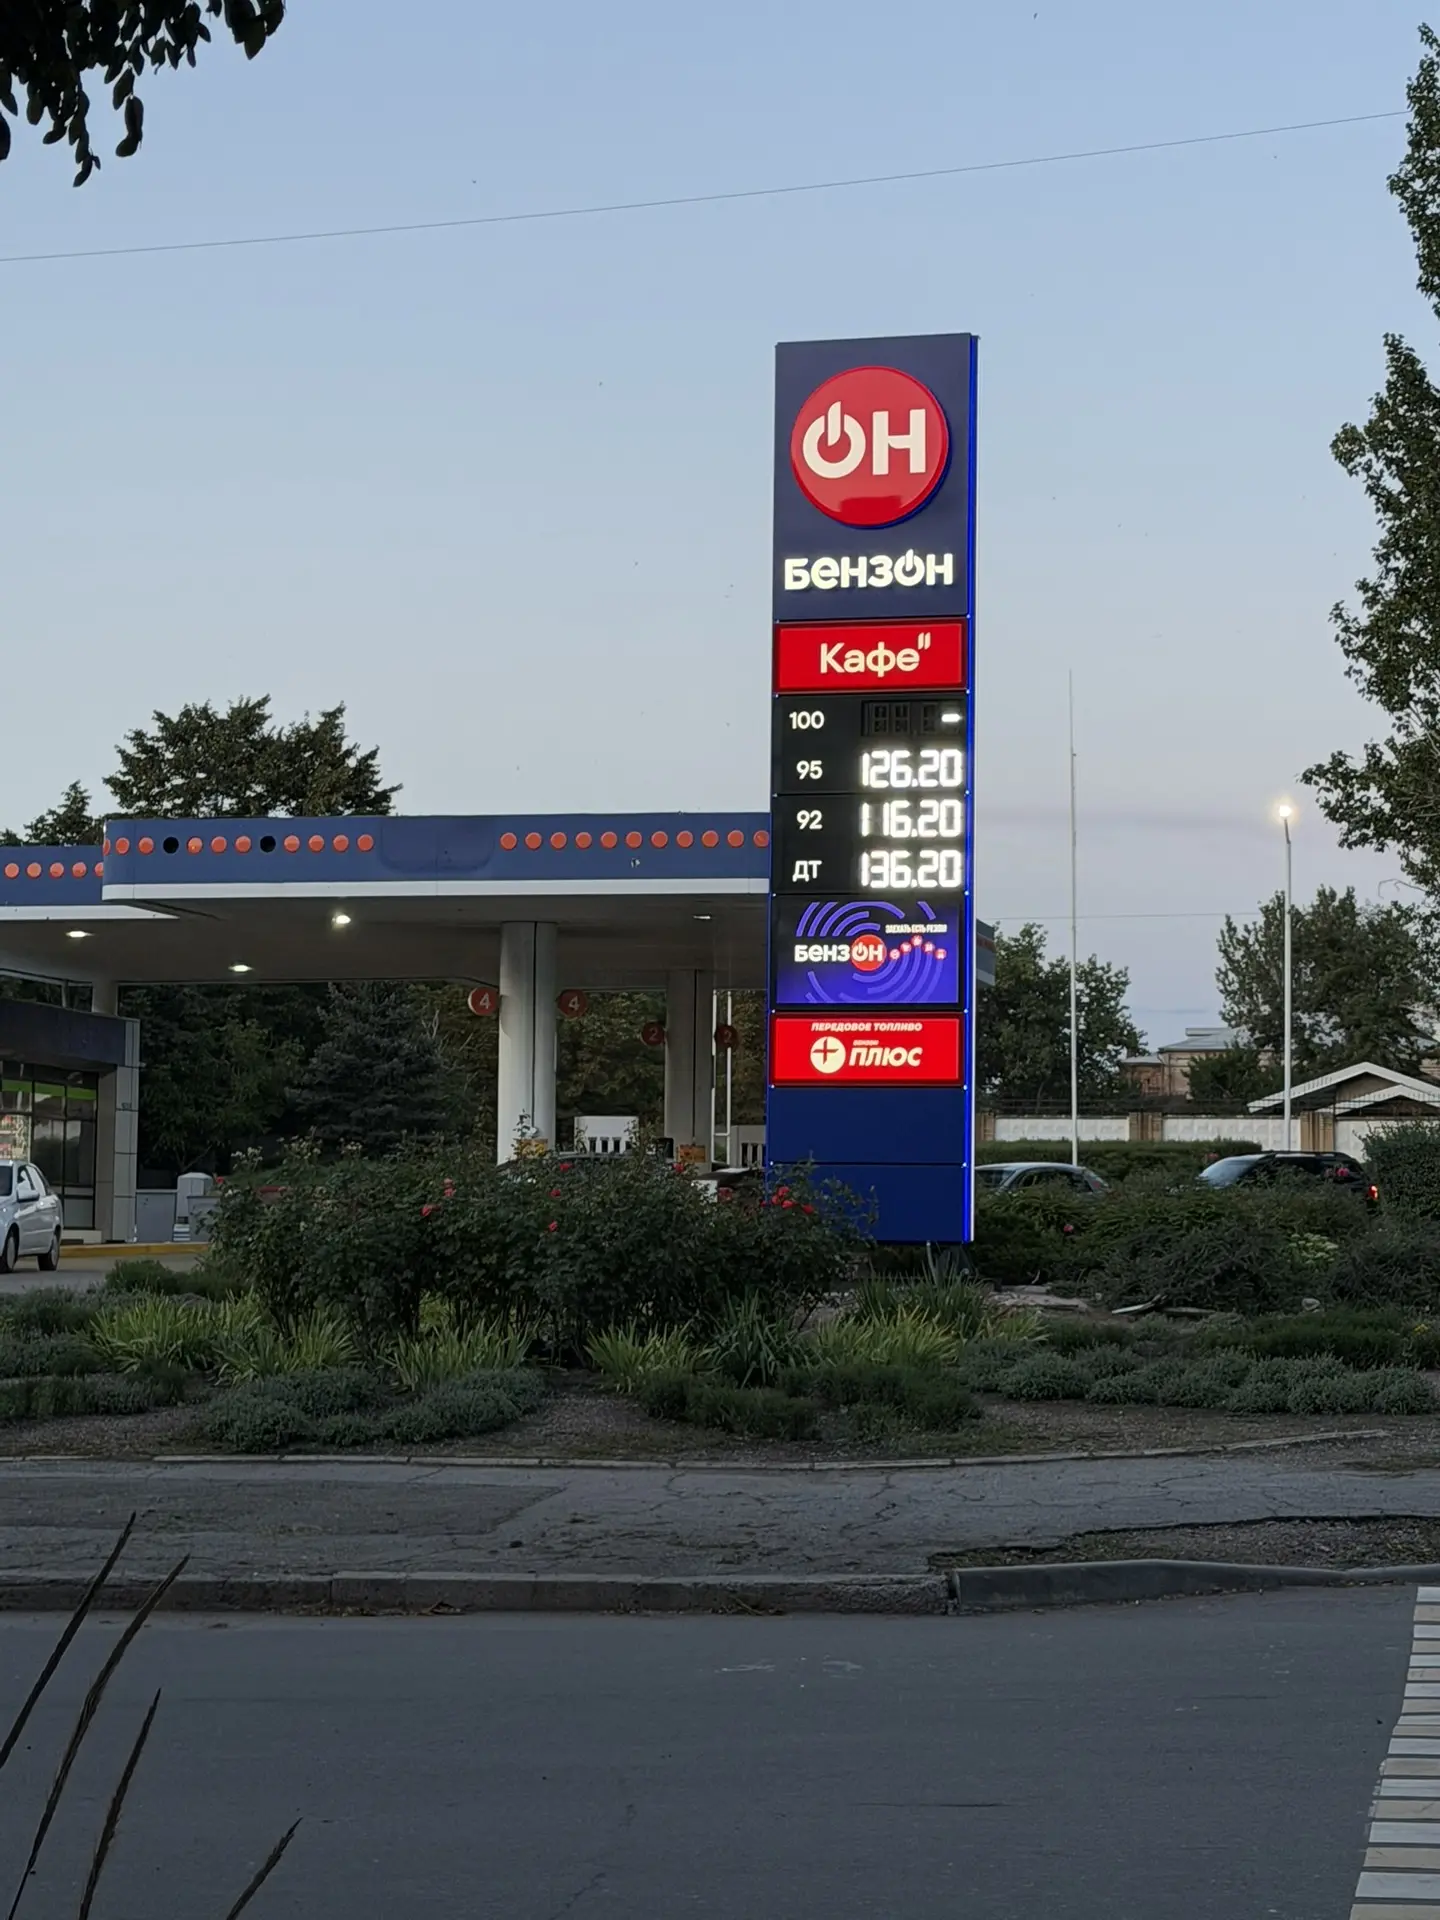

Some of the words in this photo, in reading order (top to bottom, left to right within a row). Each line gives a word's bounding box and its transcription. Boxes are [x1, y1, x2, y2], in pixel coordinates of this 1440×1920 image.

[803, 401, 926, 479] ОН
[789, 711, 825, 729] 100
[796, 760, 823, 779] 95
[862, 749, 962, 788] 126.20
[796, 810, 823, 830] 92
[862, 799, 962, 838] 116.20
[792, 860, 823, 882] ДТ
[861, 849, 962, 888] 136.20
[479, 992, 490, 1010] 4
[568, 996, 580, 1012] 4
[649, 1028, 659, 1041] 2
[811, 1022, 872, 1032] ПЕРЕДОВОЕ
[873, 1022, 923, 1031] ТОПЛИВО
[848, 1046, 923, 1067] ПЛЮС
